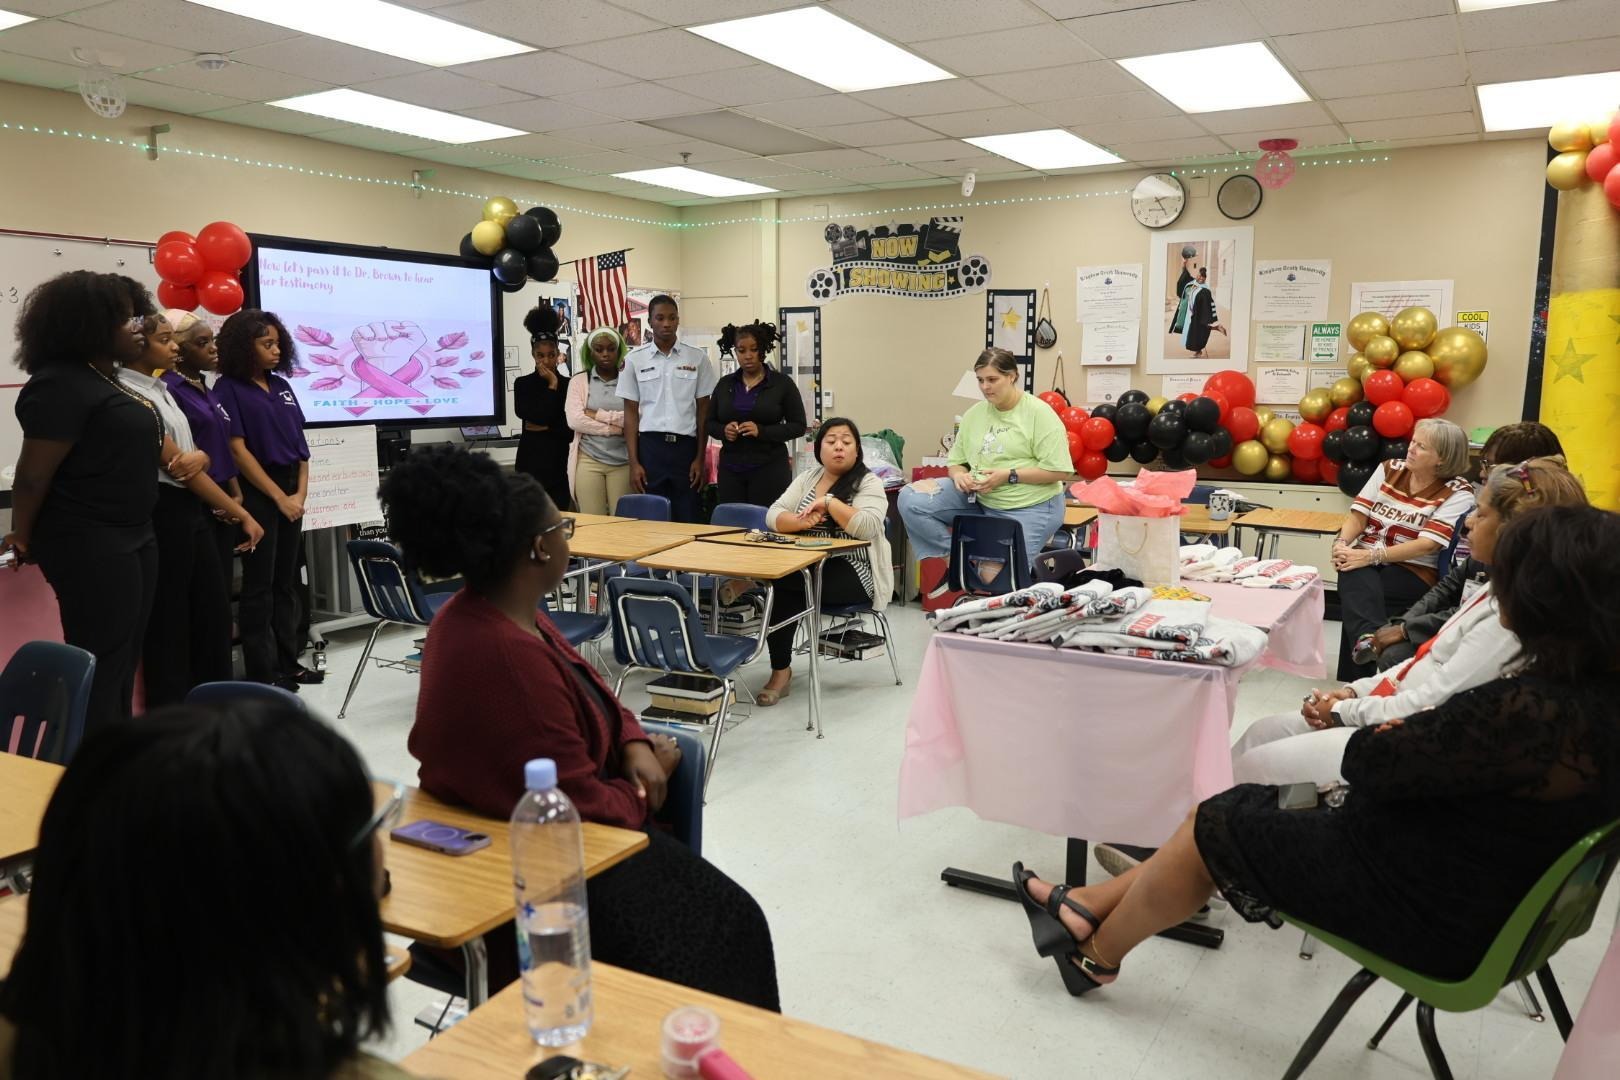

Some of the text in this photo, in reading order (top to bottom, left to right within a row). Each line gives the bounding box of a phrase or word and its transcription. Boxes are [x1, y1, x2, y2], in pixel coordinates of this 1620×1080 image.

[871, 236, 918, 259] NOW
[259, 258, 280, 272] Now
[307, 265, 329, 277] pass
[333, 265, 341, 276] it
[343, 266, 351, 276] to
[355, 266, 370, 279] Dr.
[373, 268, 401, 281] Brown
[404, 271, 413, 282] to
[414, 272, 434, 284] hear
[850, 267, 946, 292] SHOWING
[259, 274, 334, 294] her testimony
[9, 286, 19, 304] 3
[1462, 313, 1484, 321] COOL
[1313, 325, 1340, 335] ALWAYS
[313, 397, 459, 407] FAITH HOPE LOVE
[359, 527, 388, 537] than you
